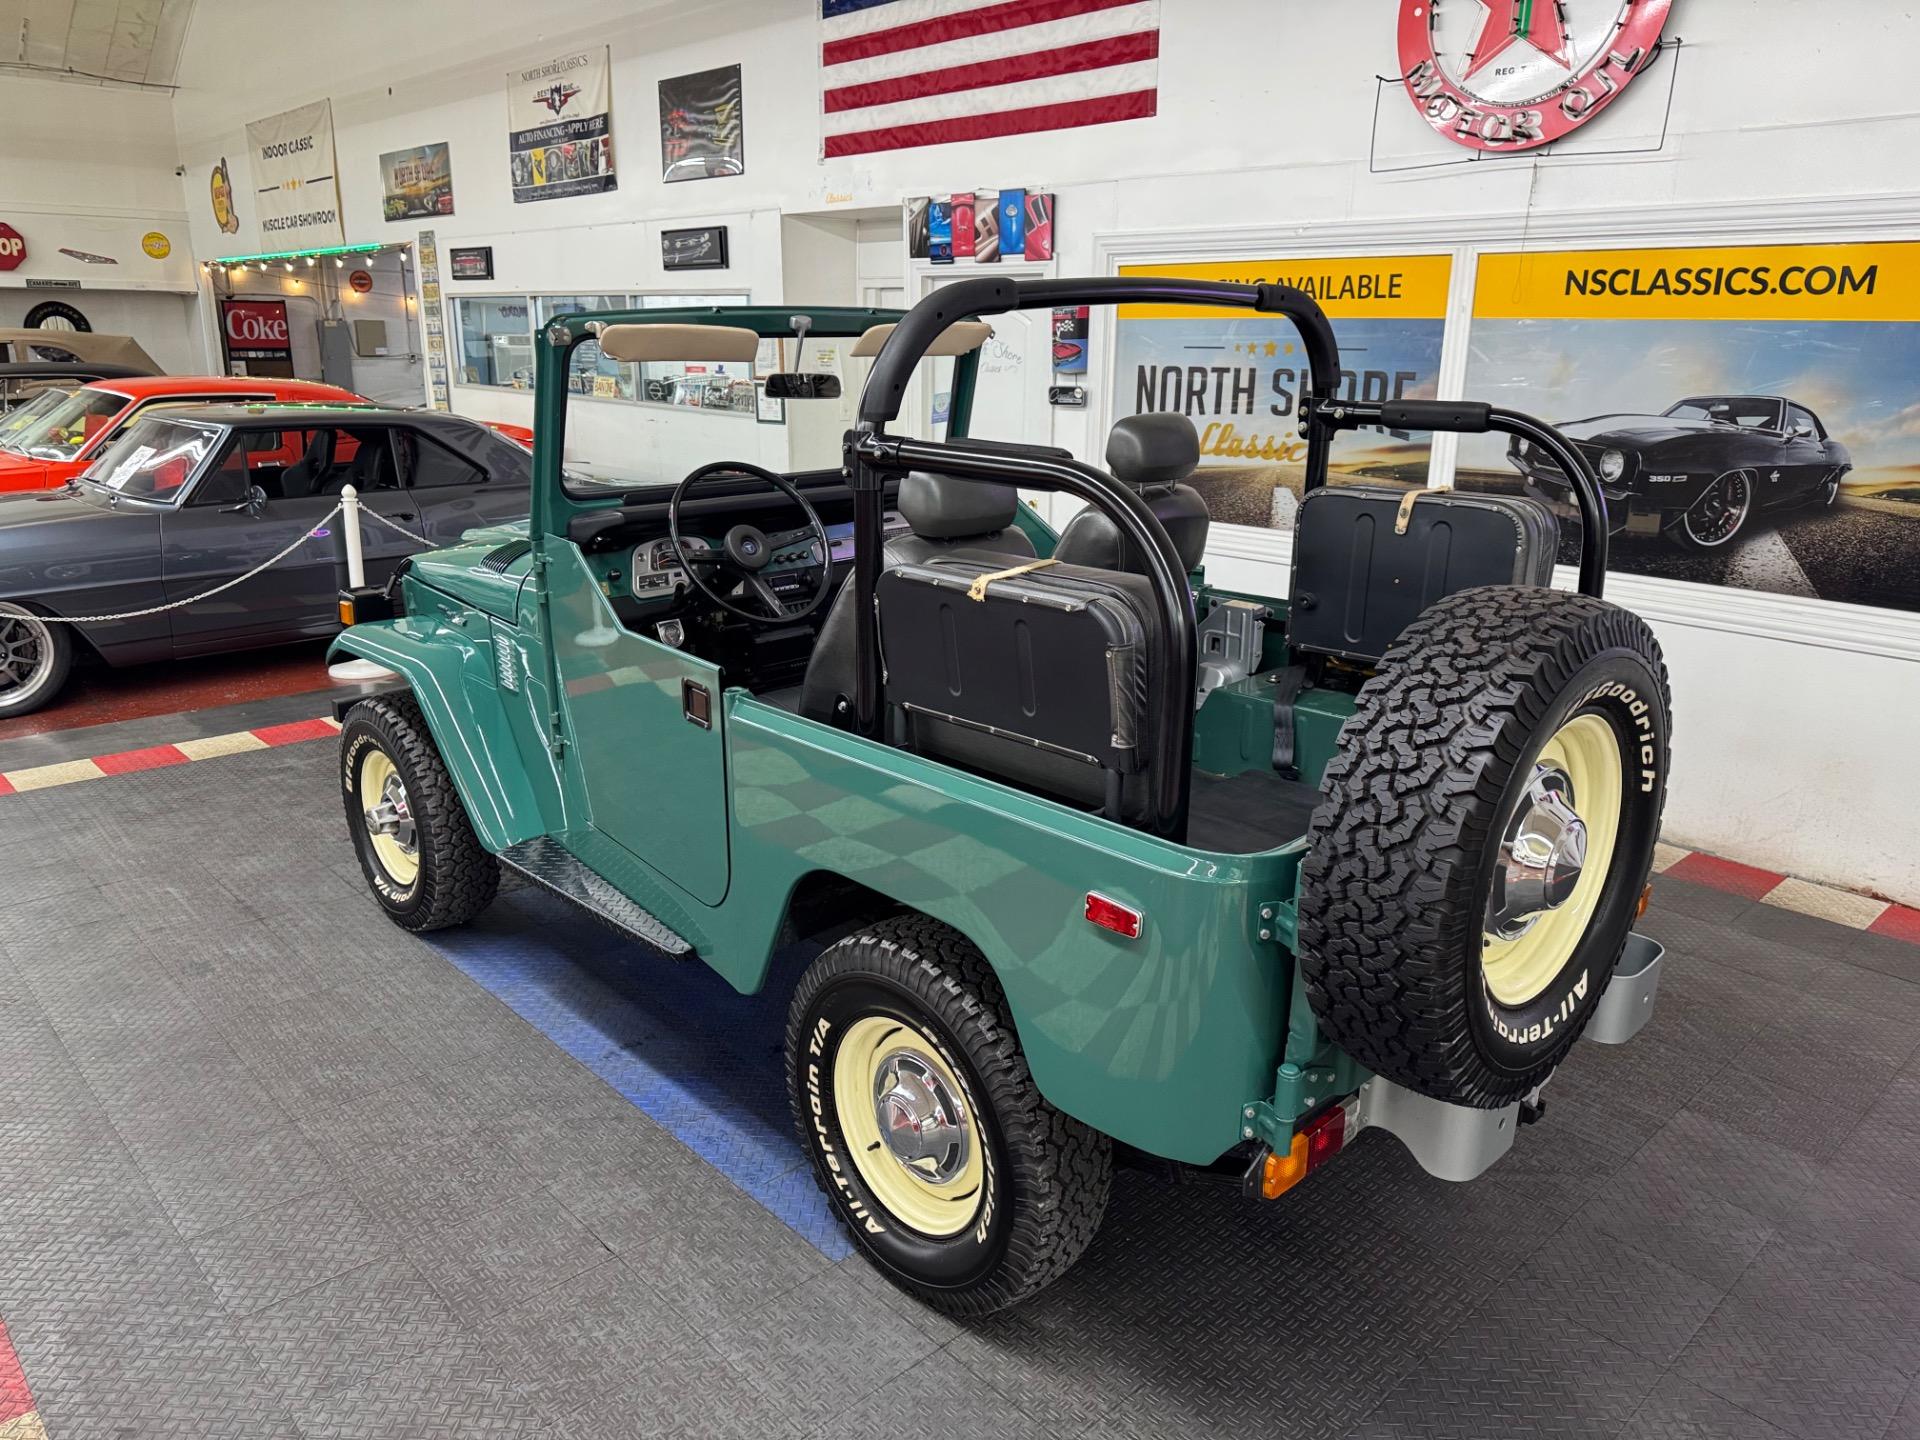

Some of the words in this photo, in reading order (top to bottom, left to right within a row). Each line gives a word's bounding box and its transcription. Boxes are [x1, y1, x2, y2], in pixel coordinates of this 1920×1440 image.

[521, 67, 541, 82] NORTH
[541, 63, 561, 77] SHORE
[1407, 59, 1545, 147] MOTOR
[1563, 46, 1646, 121] OIL
[519, 131, 534, 145] AUTO
[589, 117, 604, 131] HERE
[262, 142, 289, 160] INDOOR
[288, 135, 314, 154] CASSIC
[285, 215, 298, 229] CAR
[1565, 264, 1878, 297] NSCLASSICS.COM
[226, 309, 288, 340] Coke
[1135, 364, 1257, 417] NORTH
[374, 874, 391, 897] T/A
[1486, 968, 1588, 1046] All-Terrain
[810, 1016, 832, 1058] T/A
[806, 1063, 887, 1235] All-Terrain
